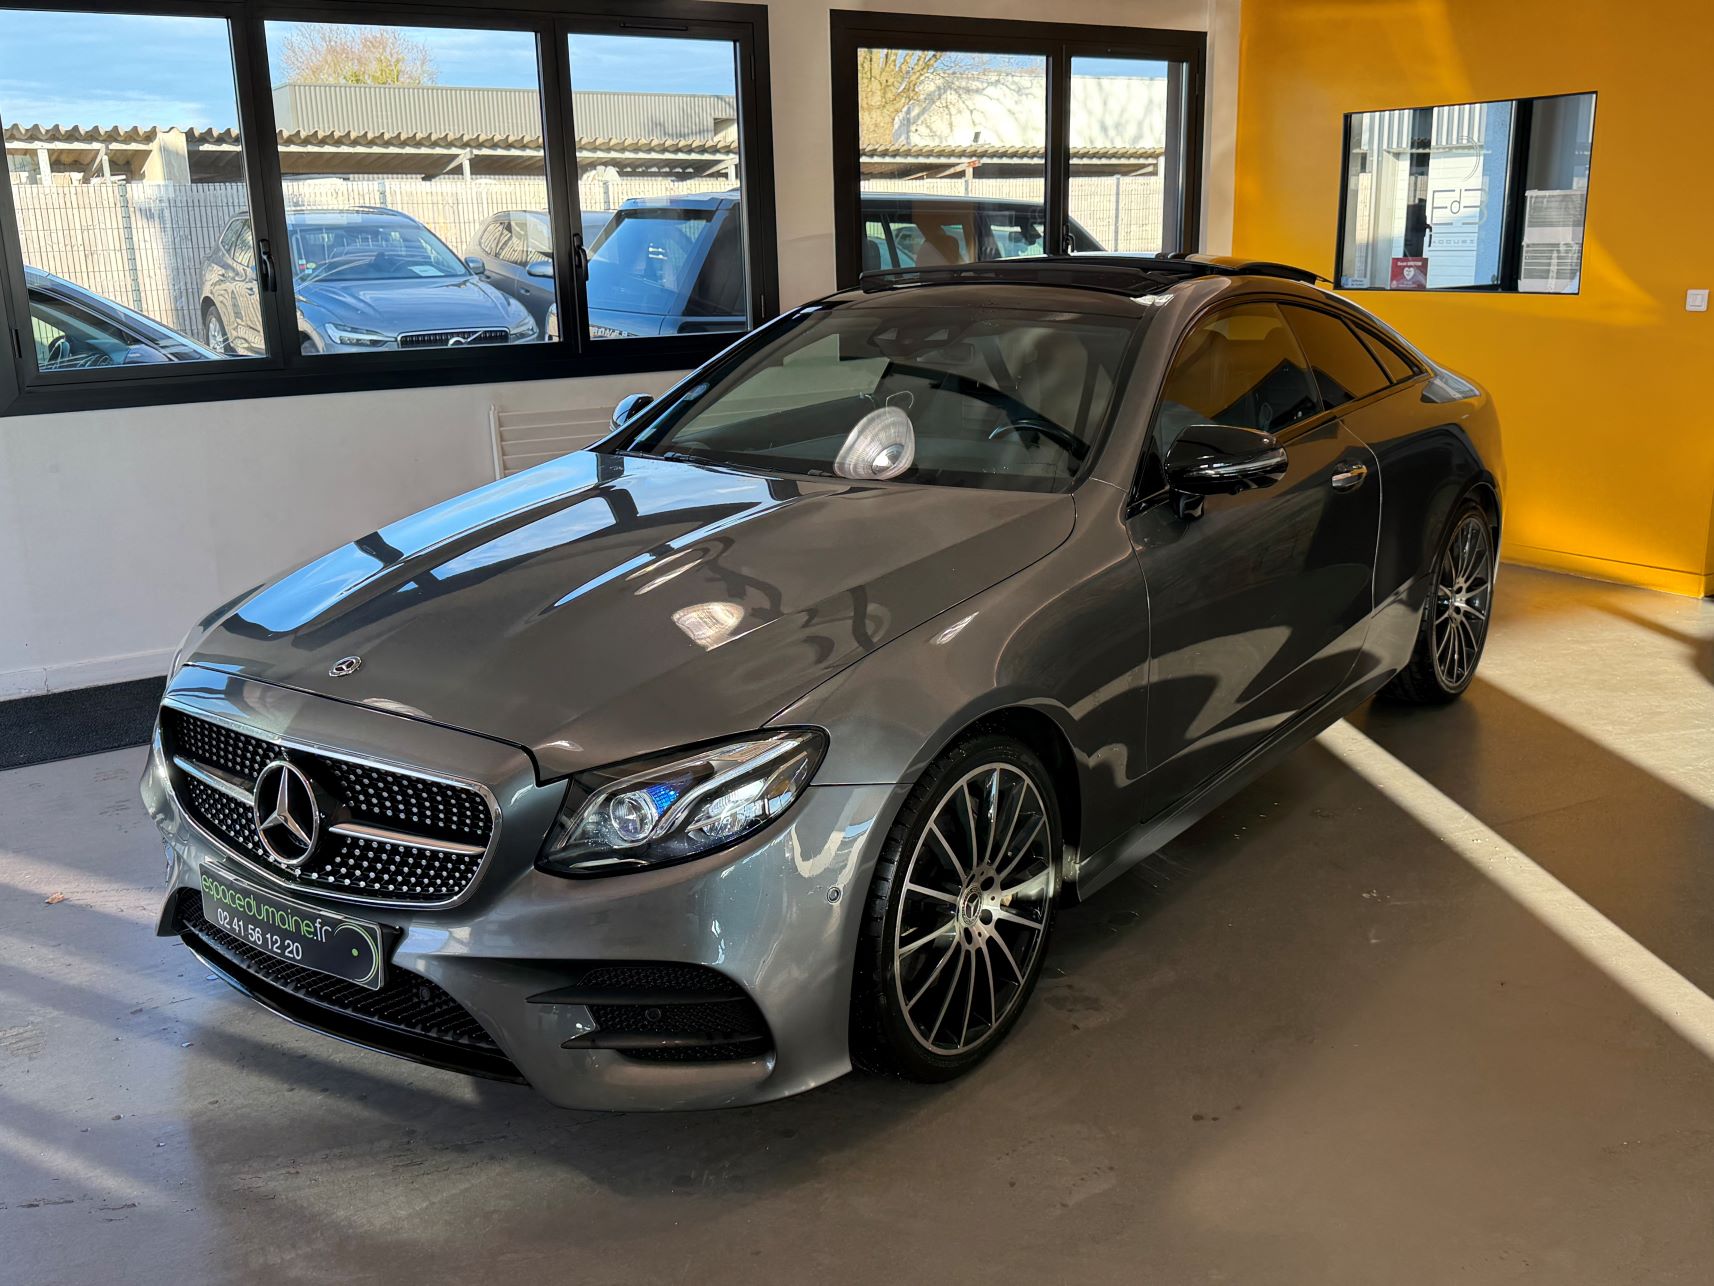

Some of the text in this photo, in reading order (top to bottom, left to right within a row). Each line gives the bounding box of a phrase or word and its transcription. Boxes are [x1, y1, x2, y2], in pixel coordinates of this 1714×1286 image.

[202, 874, 332, 943] espacedumaine.fr
[217, 908, 303, 960] 02 41 56 12 20
